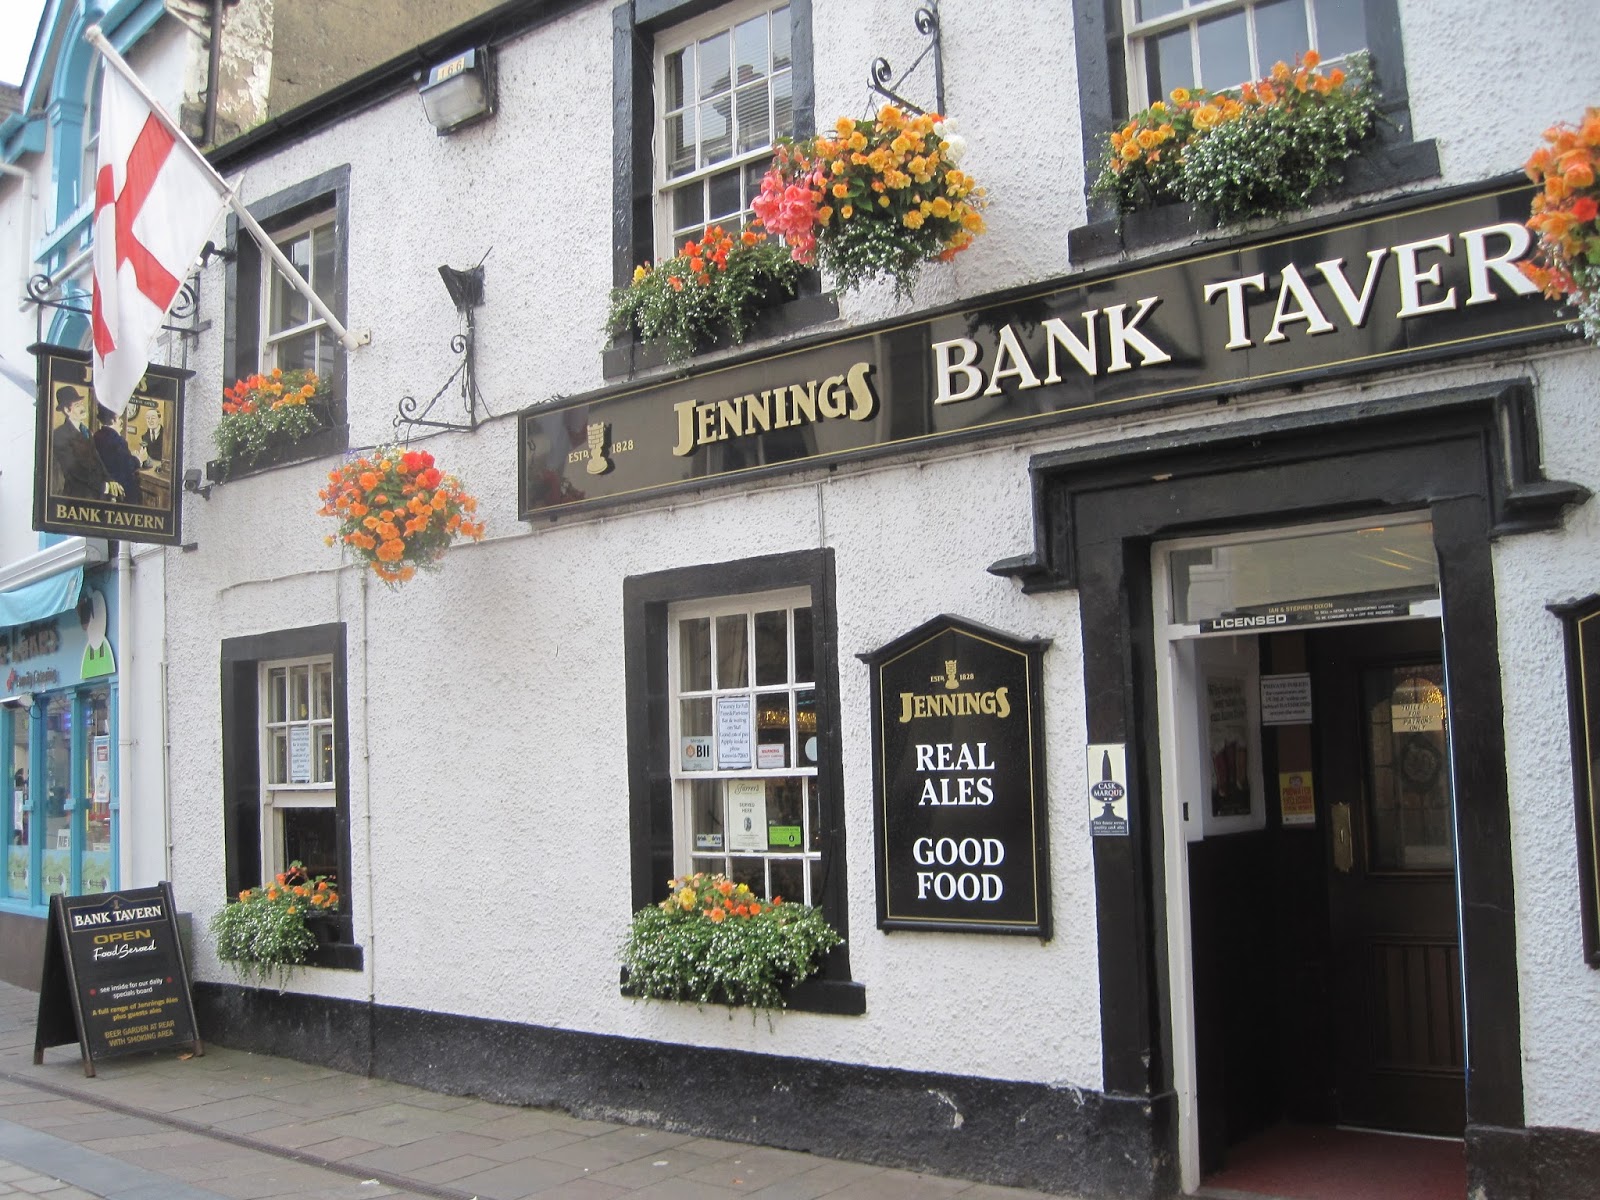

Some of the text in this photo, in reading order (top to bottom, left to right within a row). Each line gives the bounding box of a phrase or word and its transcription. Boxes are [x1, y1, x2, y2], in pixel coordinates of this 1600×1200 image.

[672, 222, 1540, 457] JENNINGS BANK TAVER
[611, 439, 634, 454] 1828
[56, 504, 165, 530] BANK TAVERN
[1285, 604, 1313, 612] STEPHEN
[1212, 613, 1287, 629] LICENSED
[959, 673, 975, 681] 1828
[899, 687, 1011, 723] JENNINGS
[915, 742, 995, 772] REAL
[918, 777, 994, 806] ALES
[1093, 789, 1123, 797] MARQUE
[58, 835, 70, 848] NE
[913, 837, 1005, 867] GOOD
[917, 872, 1003, 901] FOOD
[74, 905, 162, 927] BANK TAVERN
[93, 929, 152, 945] OPEN
[111, 983, 129, 991] inside
[149, 977, 163, 986] daily
[113, 987, 153, 999] specials board
[110, 1005, 128, 1013] range
[138, 999, 165, 1009] Jennings
[112, 1013, 127, 1021] plus
[127, 1010, 148, 1019] guests
[104, 1030, 122, 1039] BEER
[122, 1024, 149, 1036] GARDEN
[158, 1019, 175, 1028] REAR
[108, 1029, 174, 1047] WITH SMOKING AREA
